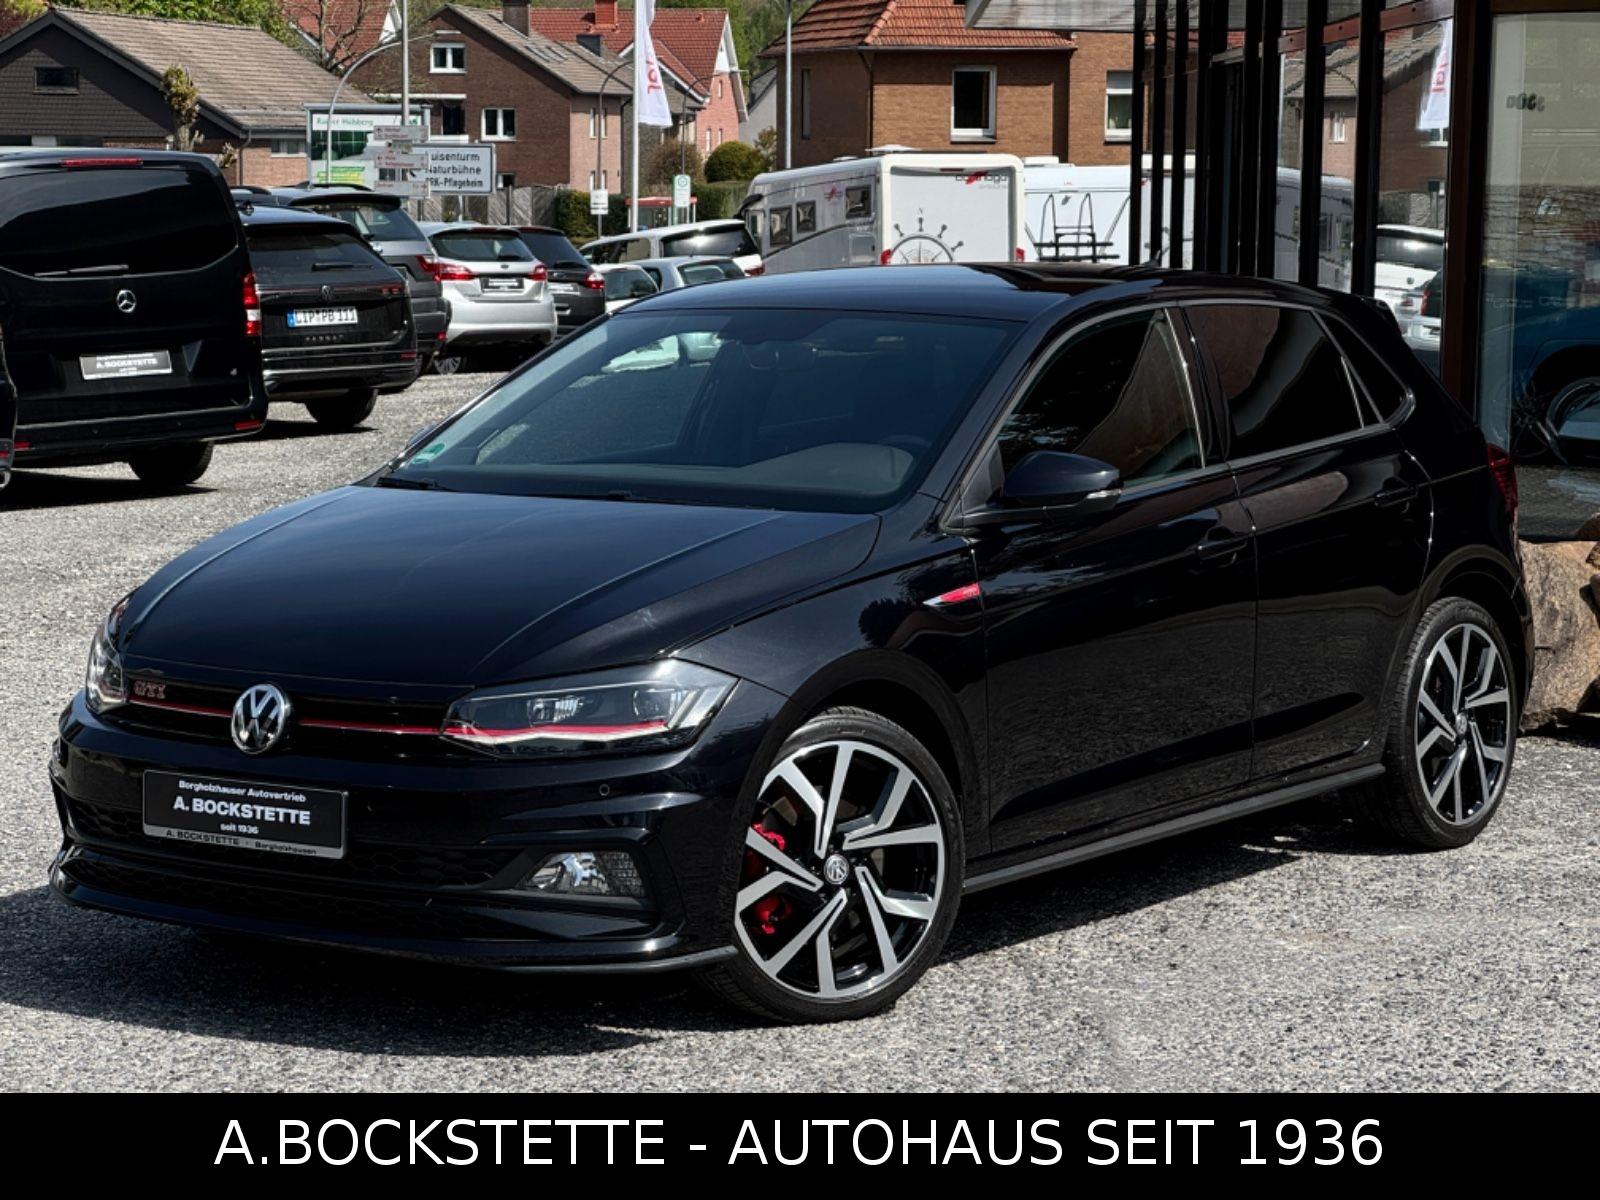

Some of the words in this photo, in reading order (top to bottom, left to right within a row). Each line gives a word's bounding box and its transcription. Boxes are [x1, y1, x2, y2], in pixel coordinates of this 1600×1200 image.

[246, 787, 306, 803] Autovertrieb
[172, 795, 190, 812] A.
[191, 797, 311, 826] BOCKSTETTE
[176, 830, 240, 846] BOCKSTETTE
